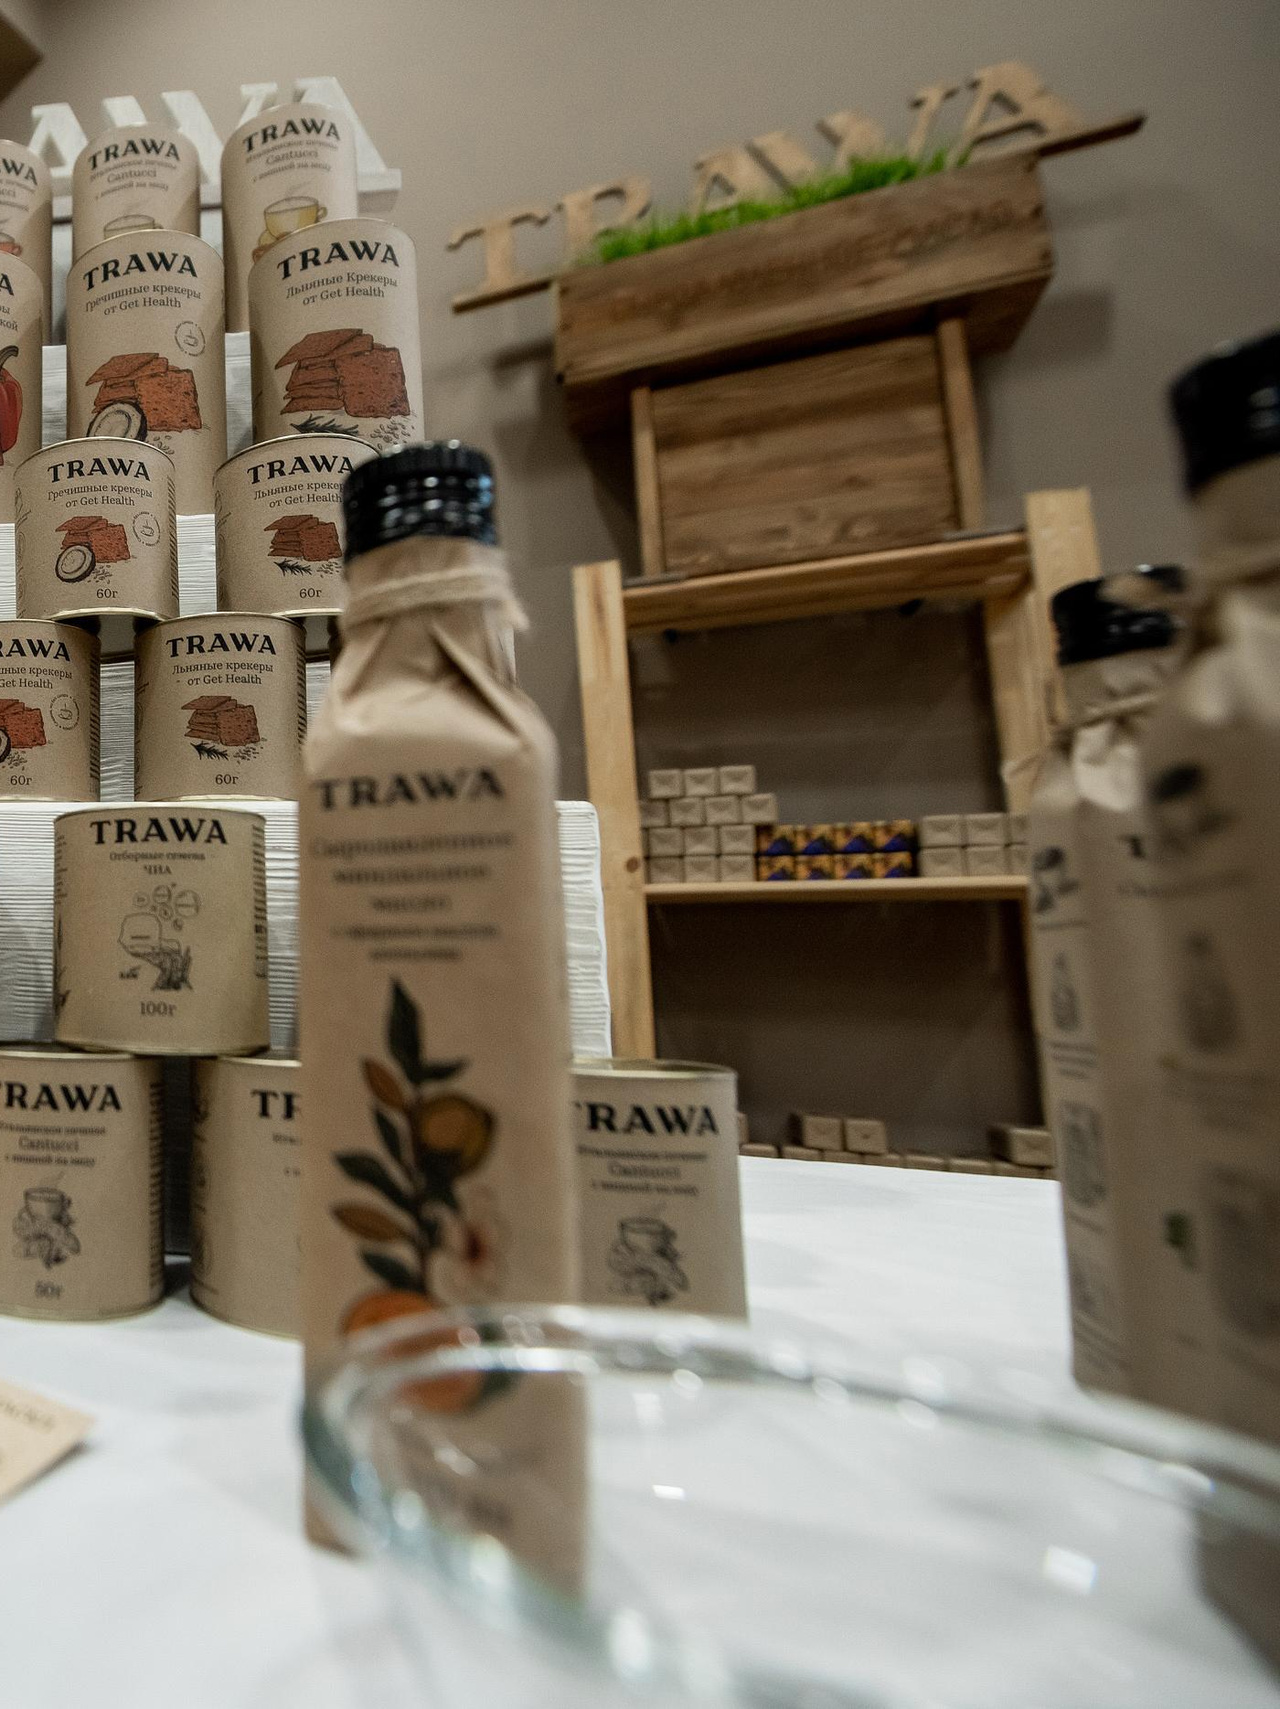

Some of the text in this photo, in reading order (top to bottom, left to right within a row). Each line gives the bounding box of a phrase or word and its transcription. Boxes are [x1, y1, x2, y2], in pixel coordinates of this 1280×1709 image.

[243, 117, 340, 152] TRAWA
[88, 138, 180, 170] TRAWA
[266, 150, 318, 165] Cantucci
[107, 169, 156, 183] Cantucci
[277, 240, 400, 281] TRAWA
[83, 251, 198, 292] TRAWA
[285, 272, 398, 300] Льняные Крекеры
[302, 285, 385, 306] от Get Health
[84, 284, 201, 313] Гречишные крекеры
[103, 297, 182, 316] от Get Health
[47, 457, 151, 483] TRAWA
[247, 455, 356, 485] TRAWA
[47, 483, 153, 501] Гречишные крекеры
[253, 481, 344, 501] Льняные крекер
[269, 492, 343, 508] от Get Health
[65, 496, 135, 508] от Get Health
[96, 588, 119, 599] 60г
[299, 588, 322, 599] 60г
[166, 632, 277, 658] TRAWA
[28, 667, 72, 680] крекеры
[172, 660, 274, 675] Льняные крекеры
[19, 678, 53, 689] Health
[188, 673, 262, 686] от Get Health
[10, 774, 32, 786] 60г
[215, 773, 239, 785] 60г
[310, 765, 507, 812] TRAWA
[90, 817, 227, 845] TRAWA
[140, 1001, 177, 1016] 100г
[575, 1102, 719, 1137] RAWA
